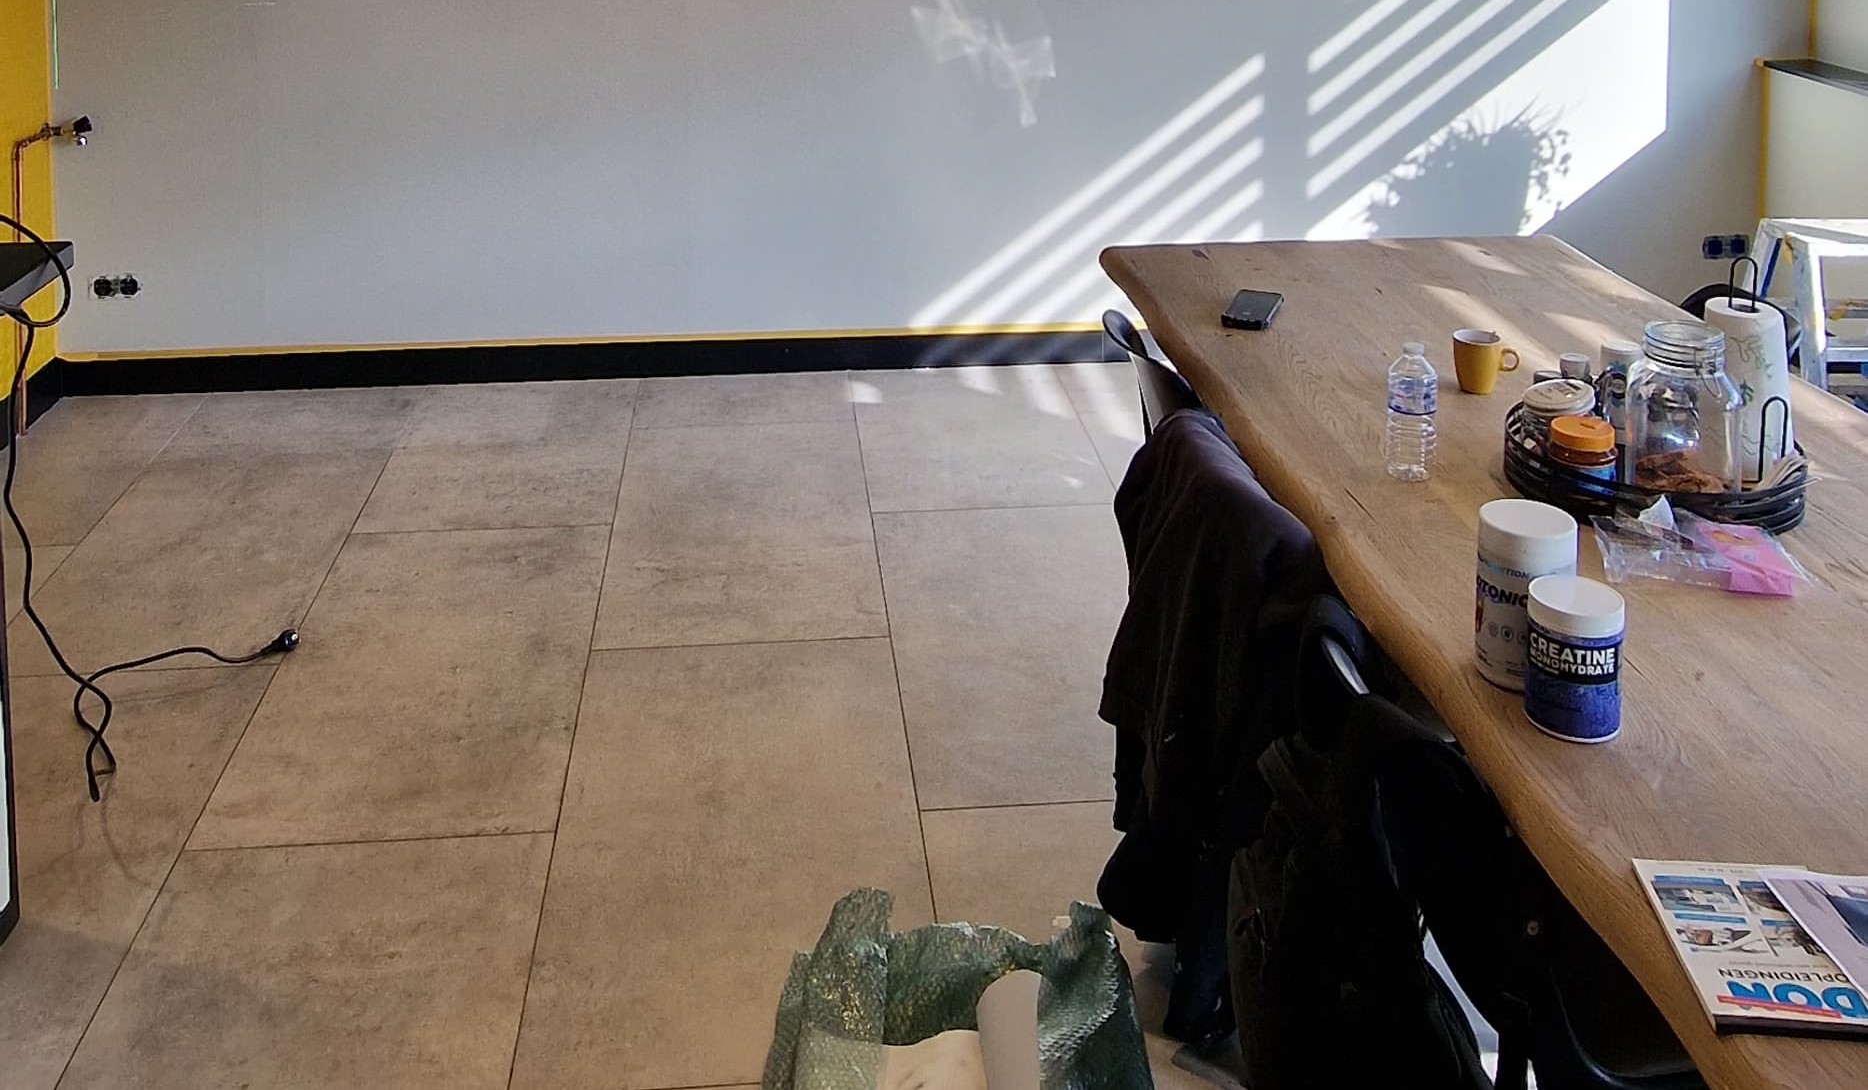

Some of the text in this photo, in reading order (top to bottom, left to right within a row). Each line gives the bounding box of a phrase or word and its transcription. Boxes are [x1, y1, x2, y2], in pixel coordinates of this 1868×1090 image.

[1529, 632, 1616, 665] CREATINE
[1529, 646, 1615, 676] MONOHYDRATE
[1717, 968, 1851, 984] OPLEIDINGEN
